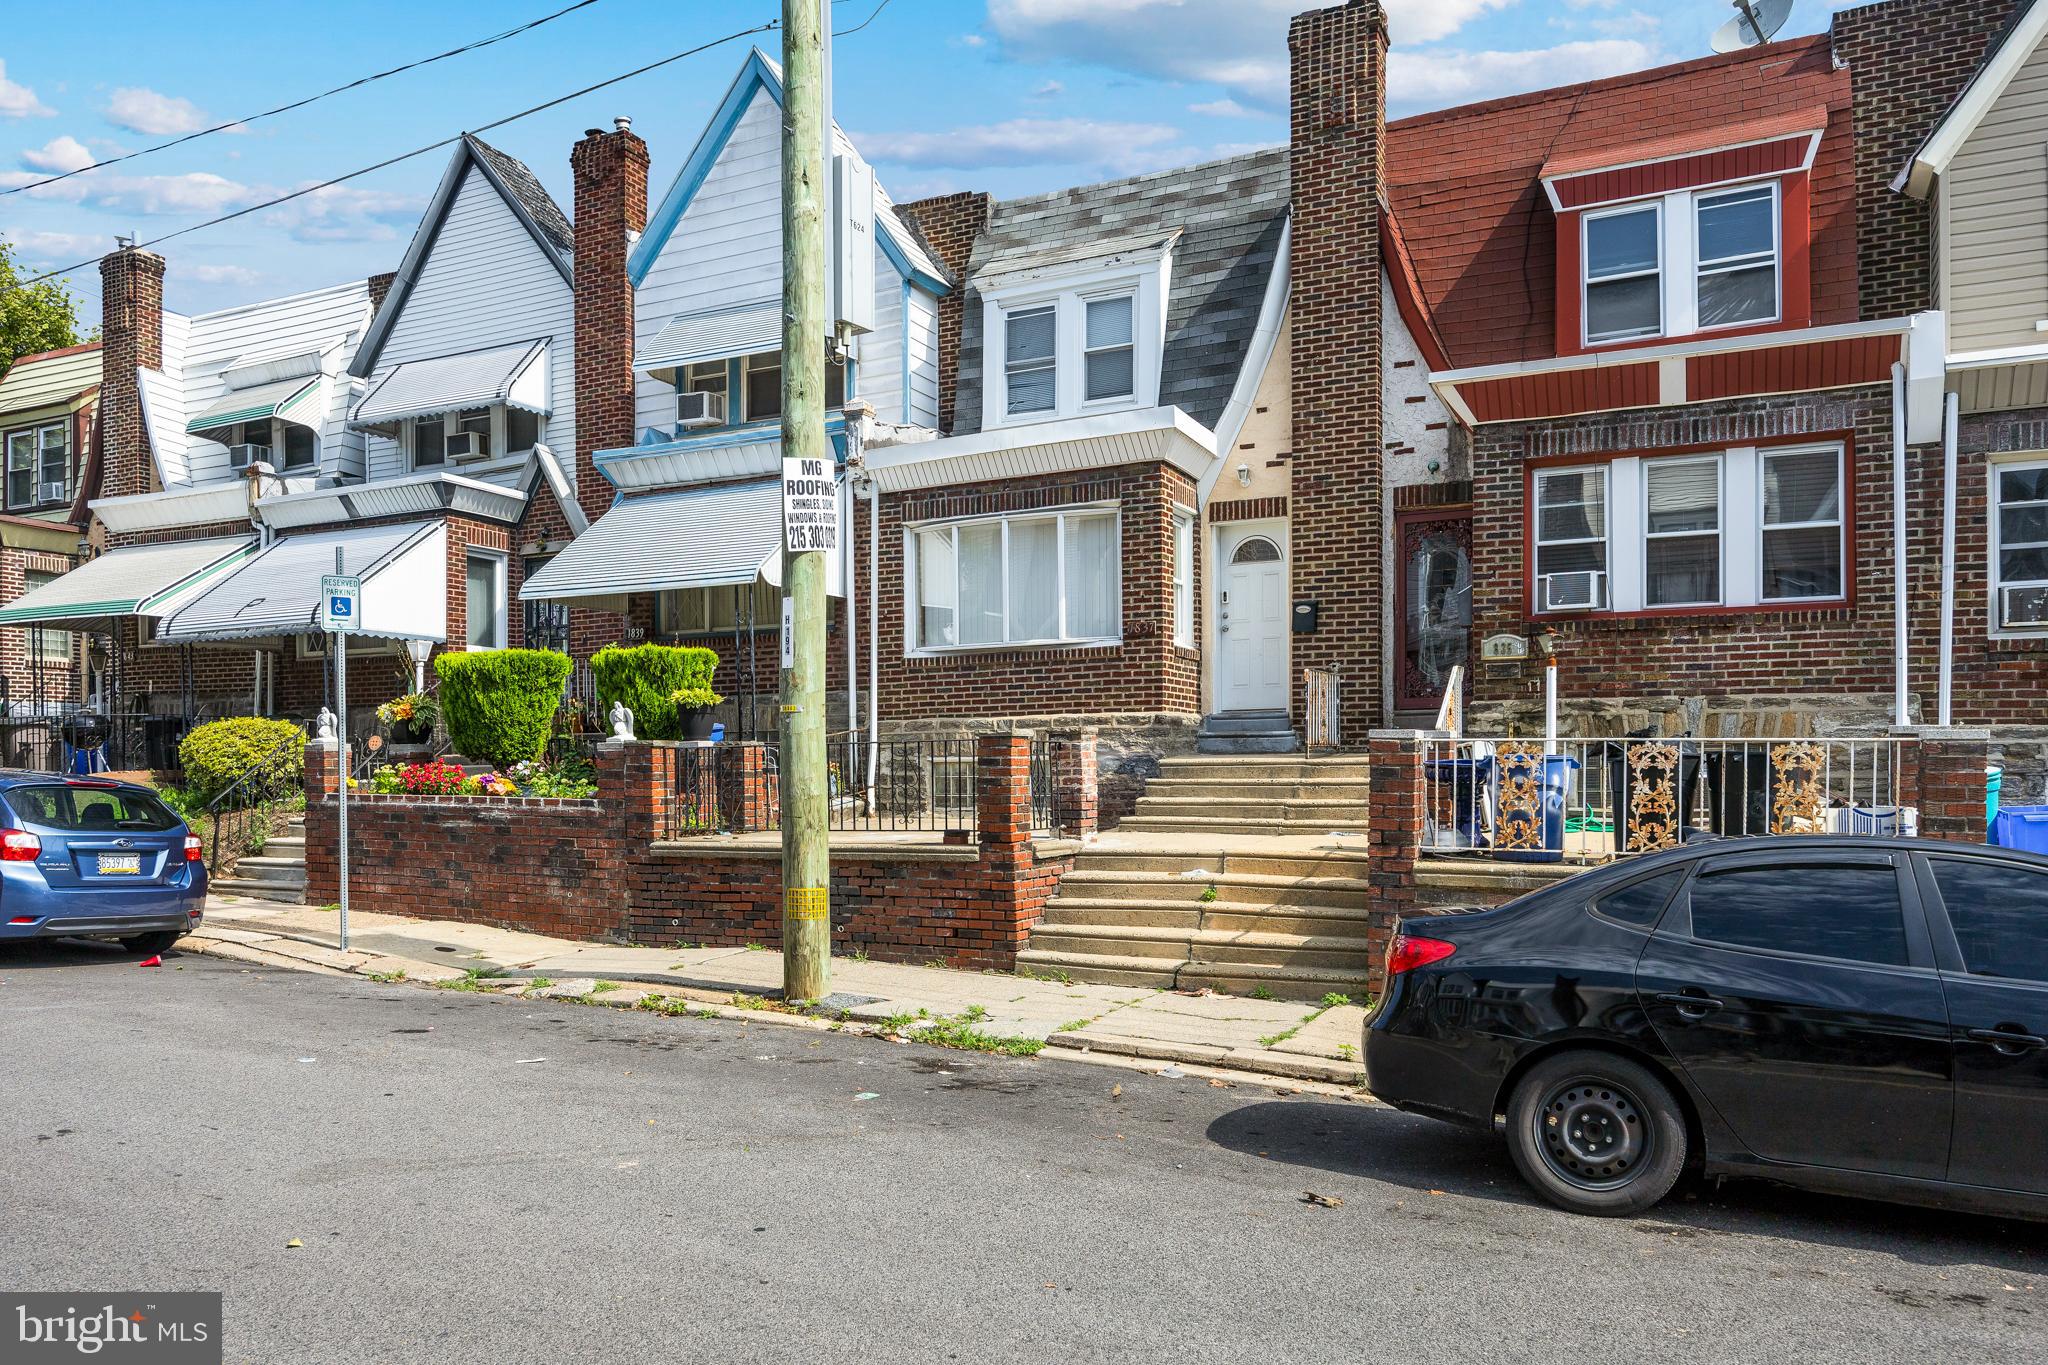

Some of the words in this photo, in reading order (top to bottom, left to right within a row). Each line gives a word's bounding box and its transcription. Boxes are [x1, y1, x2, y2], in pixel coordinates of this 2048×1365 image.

[801, 459, 822, 476] MG
[786, 479, 835, 497] ROOFING
[787, 512, 817, 524] WINDOWS
[789, 525, 806, 549] 215
[808, 525, 825, 549] 303
[323, 578, 358, 588] RESERVED
[326, 588, 356, 597] PARKING
[627, 627, 645, 639] 1839
[1128, 620, 1154, 634] 1837
